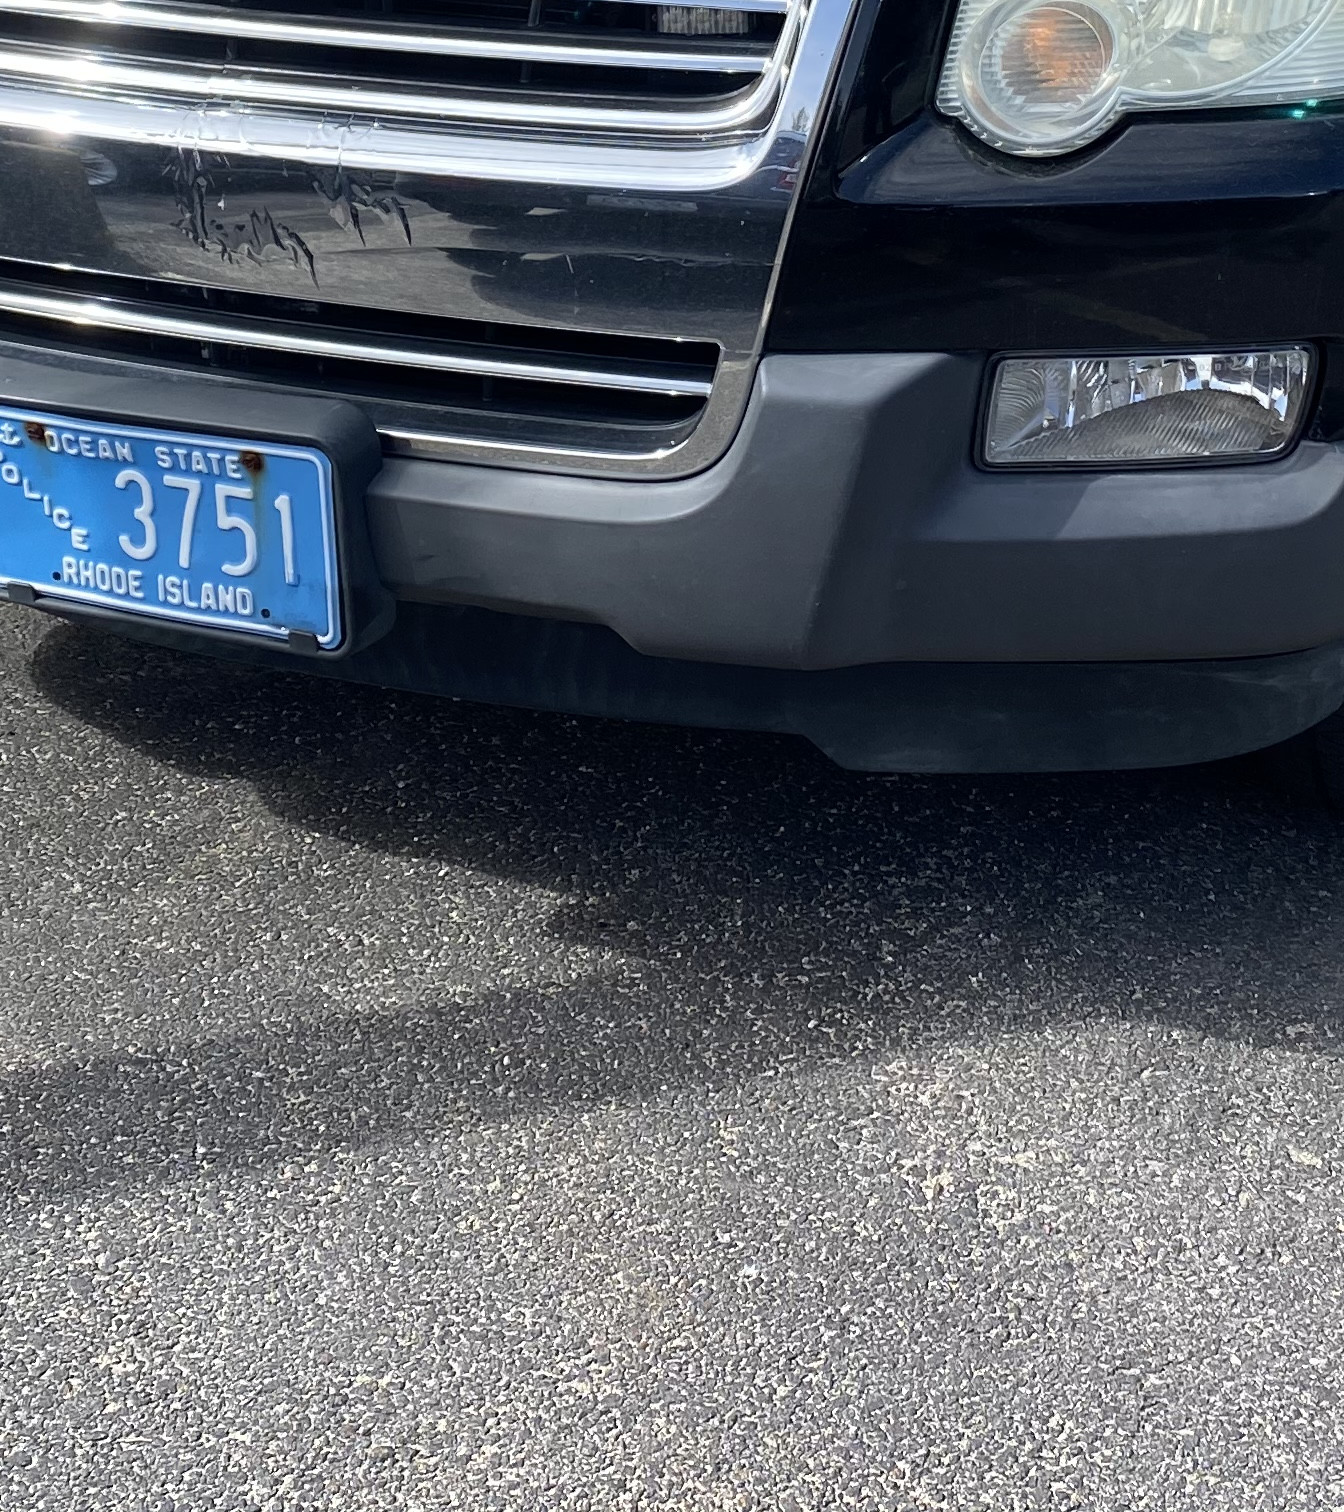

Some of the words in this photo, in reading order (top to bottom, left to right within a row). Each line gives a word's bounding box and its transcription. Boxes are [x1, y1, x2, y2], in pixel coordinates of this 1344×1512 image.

[43, 430, 134, 463] OCEAN
[154, 445, 243, 480] STATE
[114, 468, 300, 586] 3751
[61, 555, 145, 599] RHODE
[157, 573, 255, 617] ISLAND
